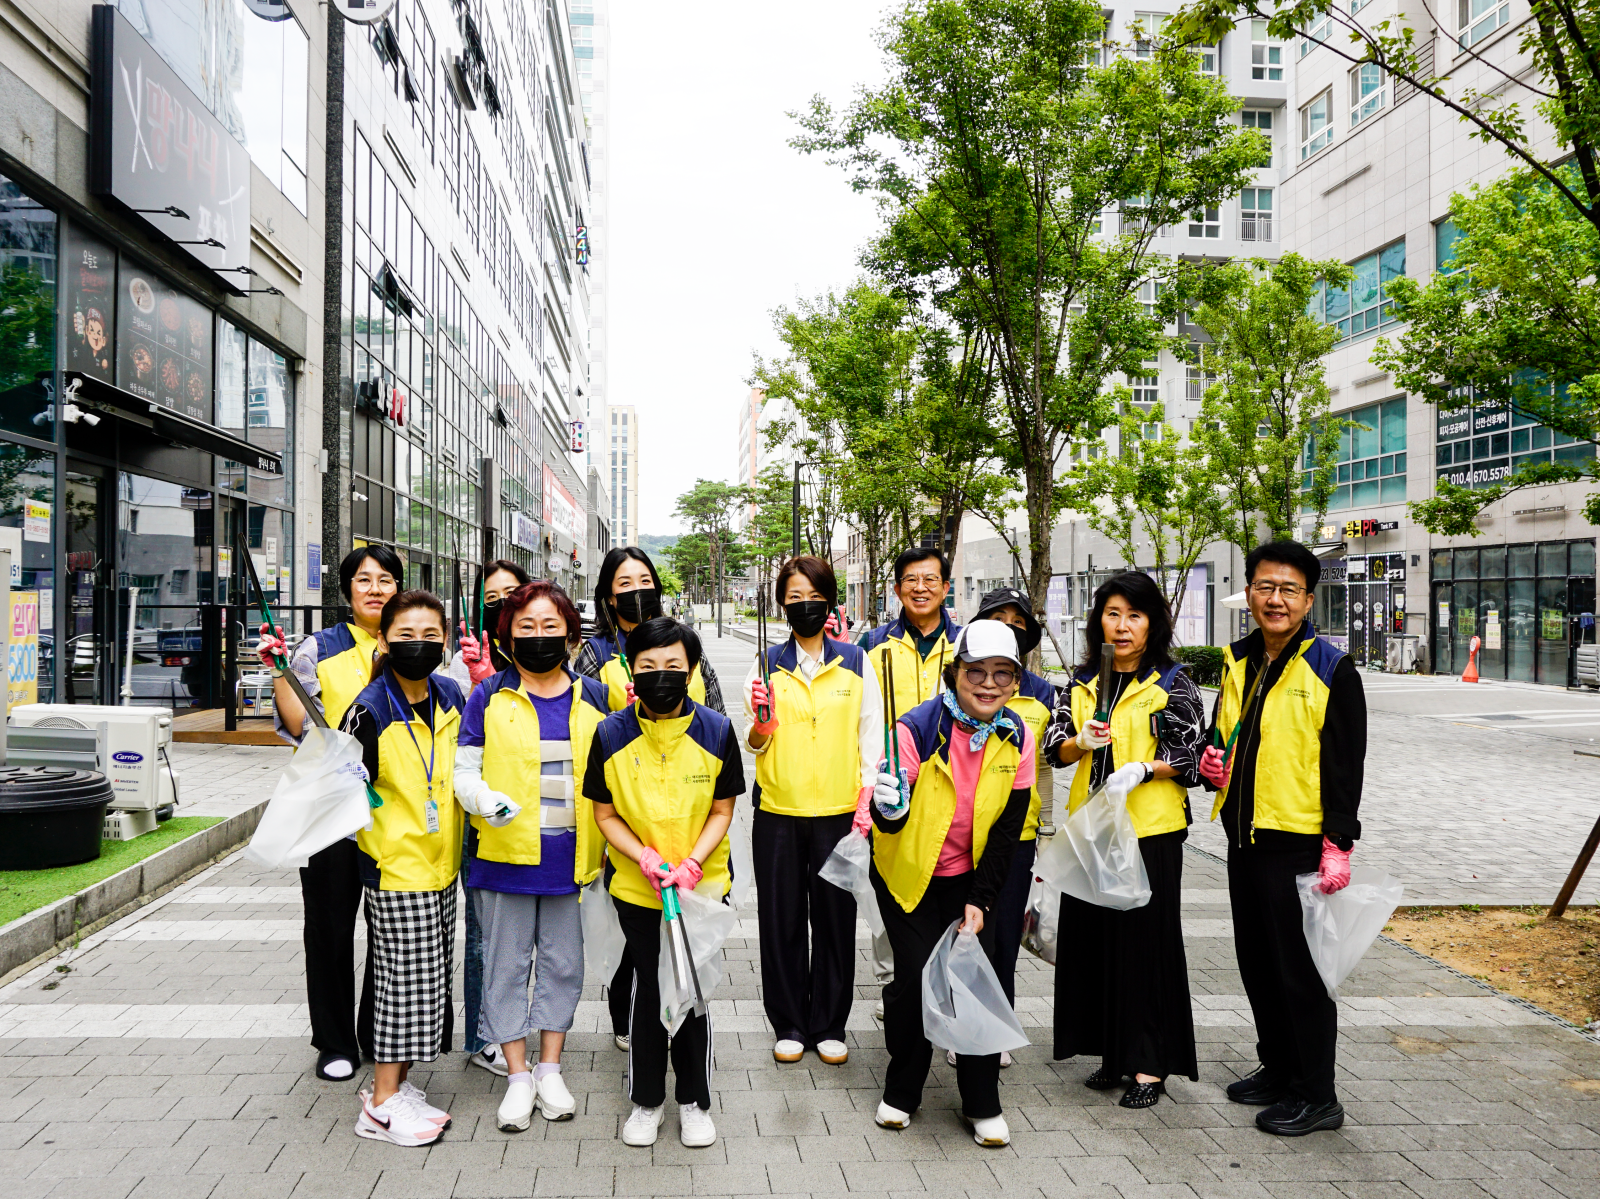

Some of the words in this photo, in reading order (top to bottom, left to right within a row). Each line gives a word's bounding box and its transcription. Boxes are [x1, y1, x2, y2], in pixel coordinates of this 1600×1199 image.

[145, 77, 219, 197] 망나니
[577, 226, 587, 264] 24시
[82, 249, 98, 269] 오늘도
[1346, 519, 1377, 538] 탱크PC
[69, 551, 92, 572] 망나니
[13, 603, 36, 637] 임대
[1395, 620, 1403, 630] PC
[8, 643, 36, 684] 5800
[116, 753, 140, 761] Carrier
